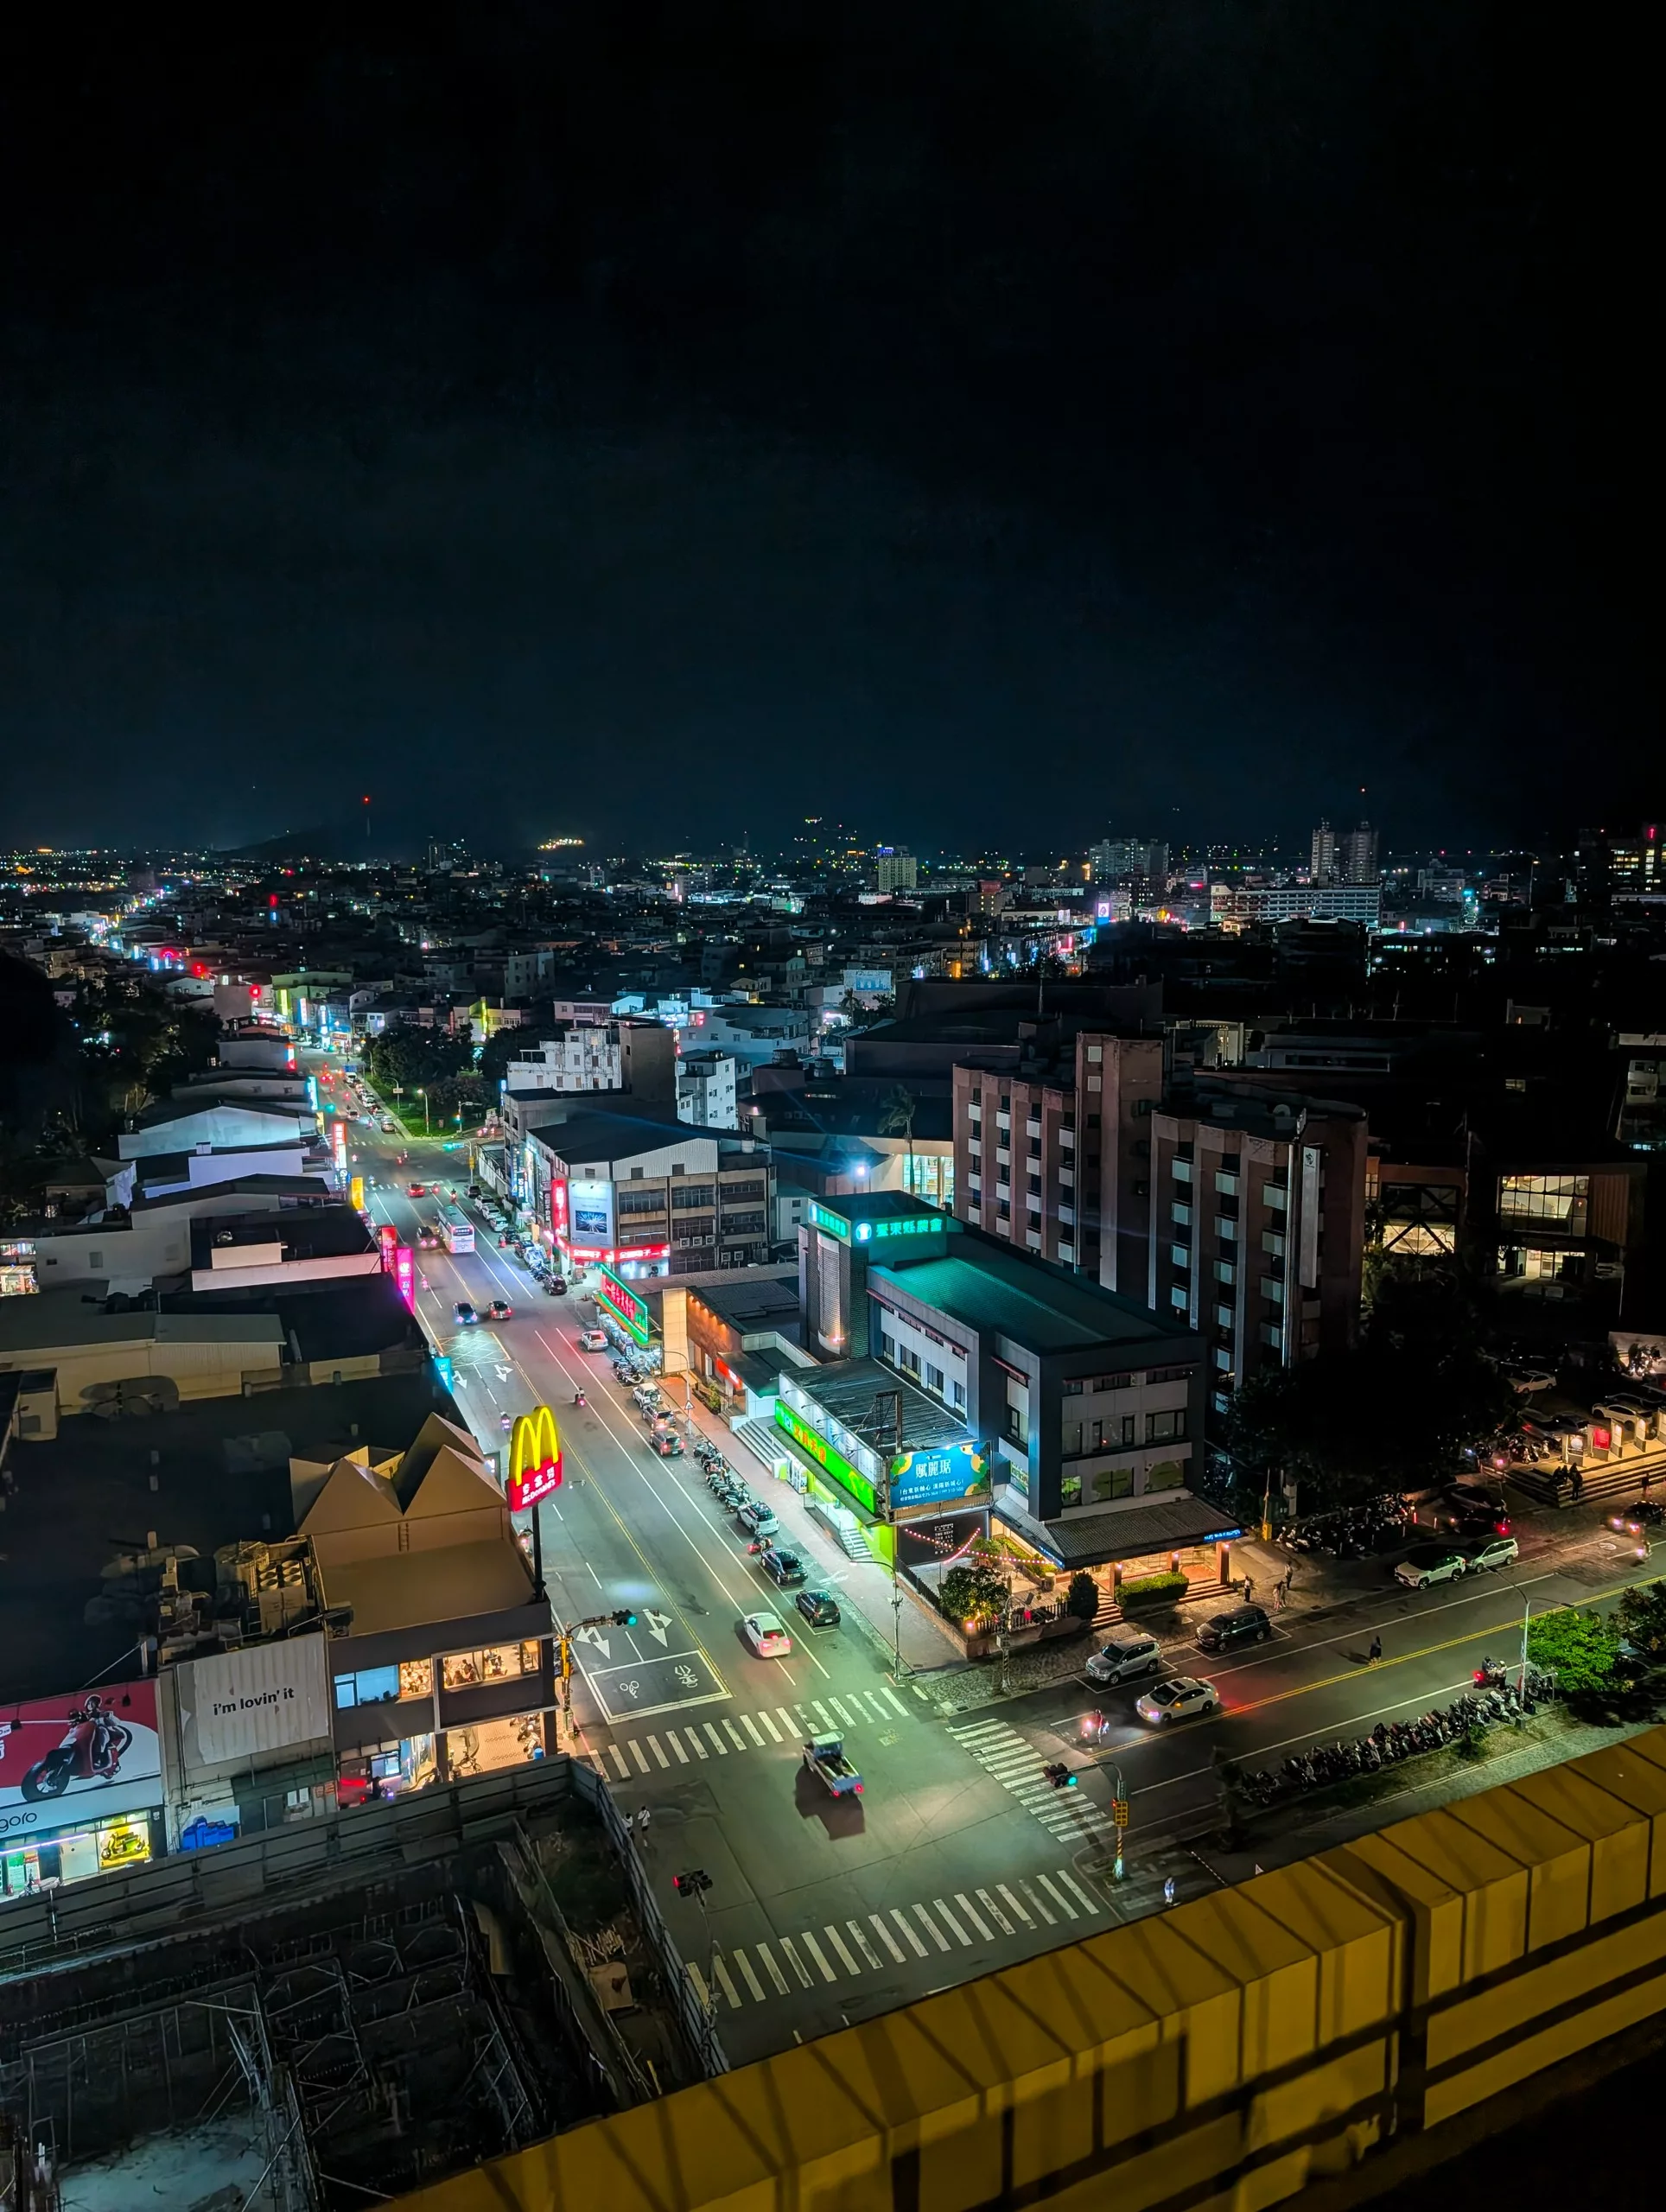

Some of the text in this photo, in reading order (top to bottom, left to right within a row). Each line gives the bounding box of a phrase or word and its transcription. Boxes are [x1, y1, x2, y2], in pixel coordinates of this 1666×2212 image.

[213, 1688, 295, 1716] i'm lovin' it
